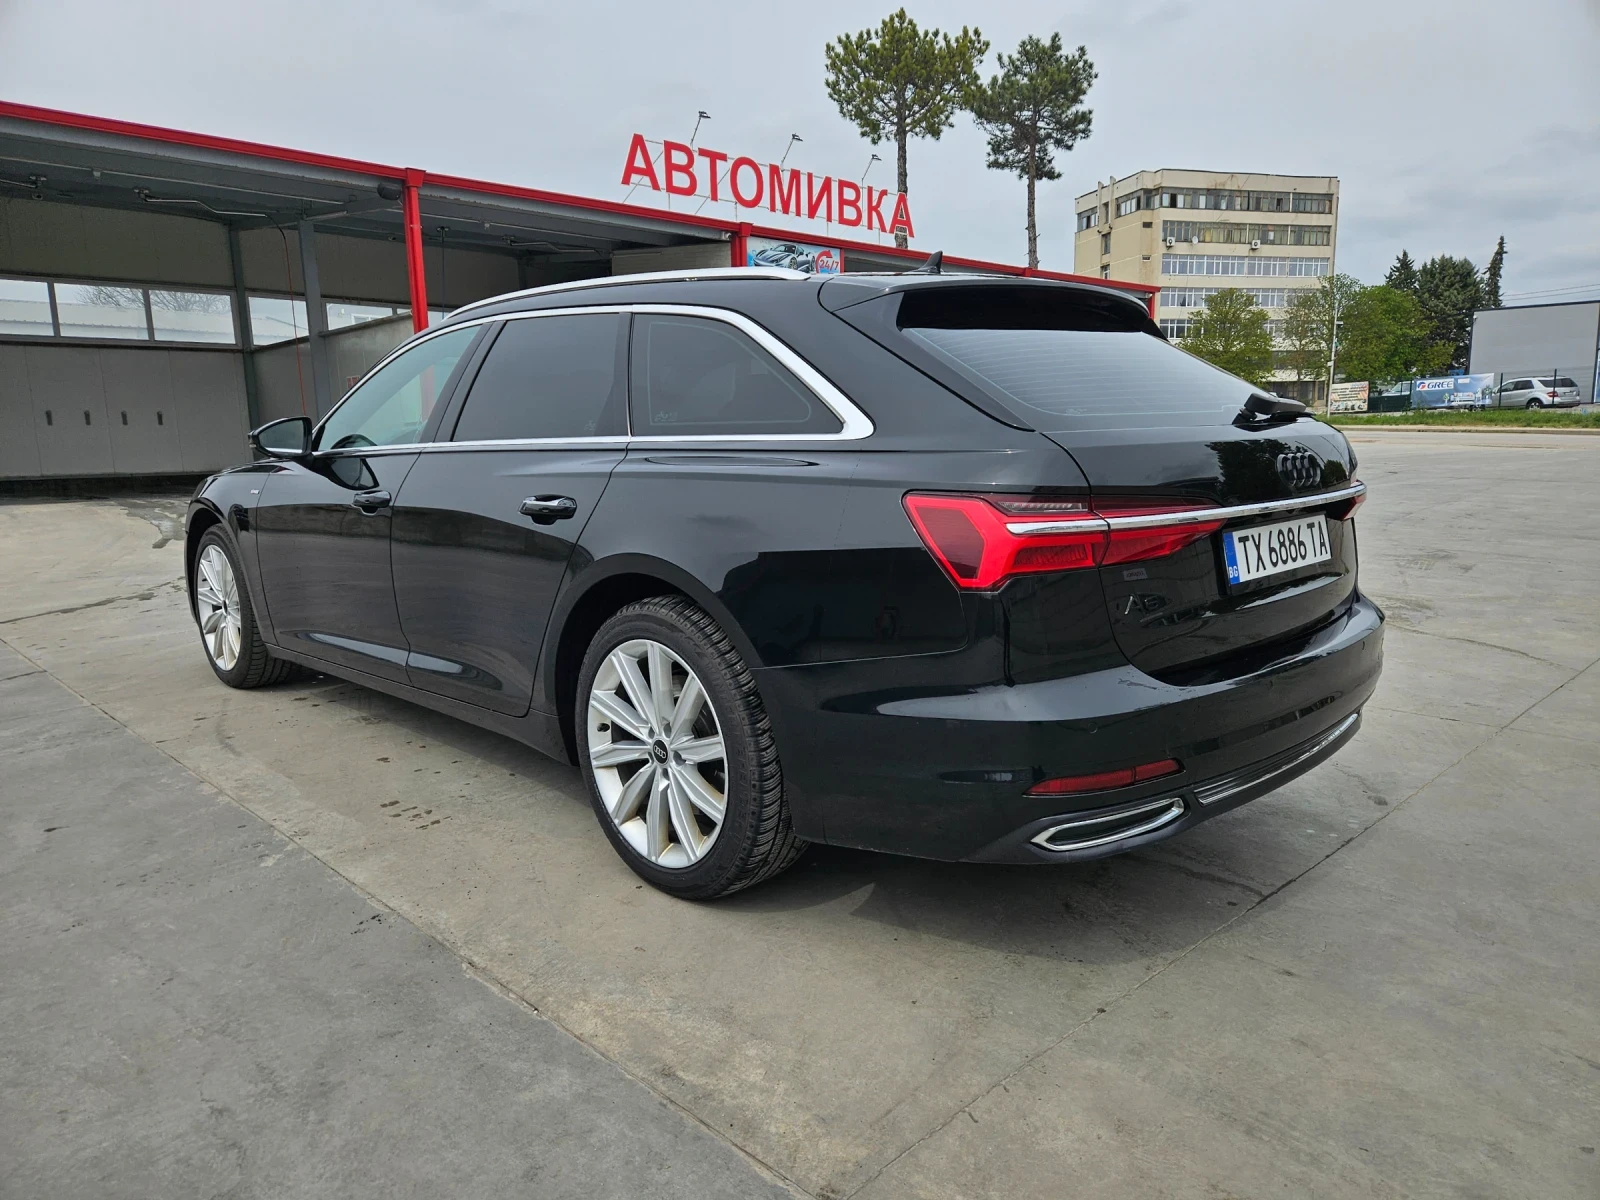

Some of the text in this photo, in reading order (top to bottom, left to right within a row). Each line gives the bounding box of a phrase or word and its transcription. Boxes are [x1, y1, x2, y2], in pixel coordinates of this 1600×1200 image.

[620, 133, 915, 238] АВТОМИВКА
[819, 259, 839, 270] 24/7
[1427, 380, 1453, 389] GREE
[1238, 520, 1328, 574] TX 6886 TA
[1229, 566, 1239, 578] BG
